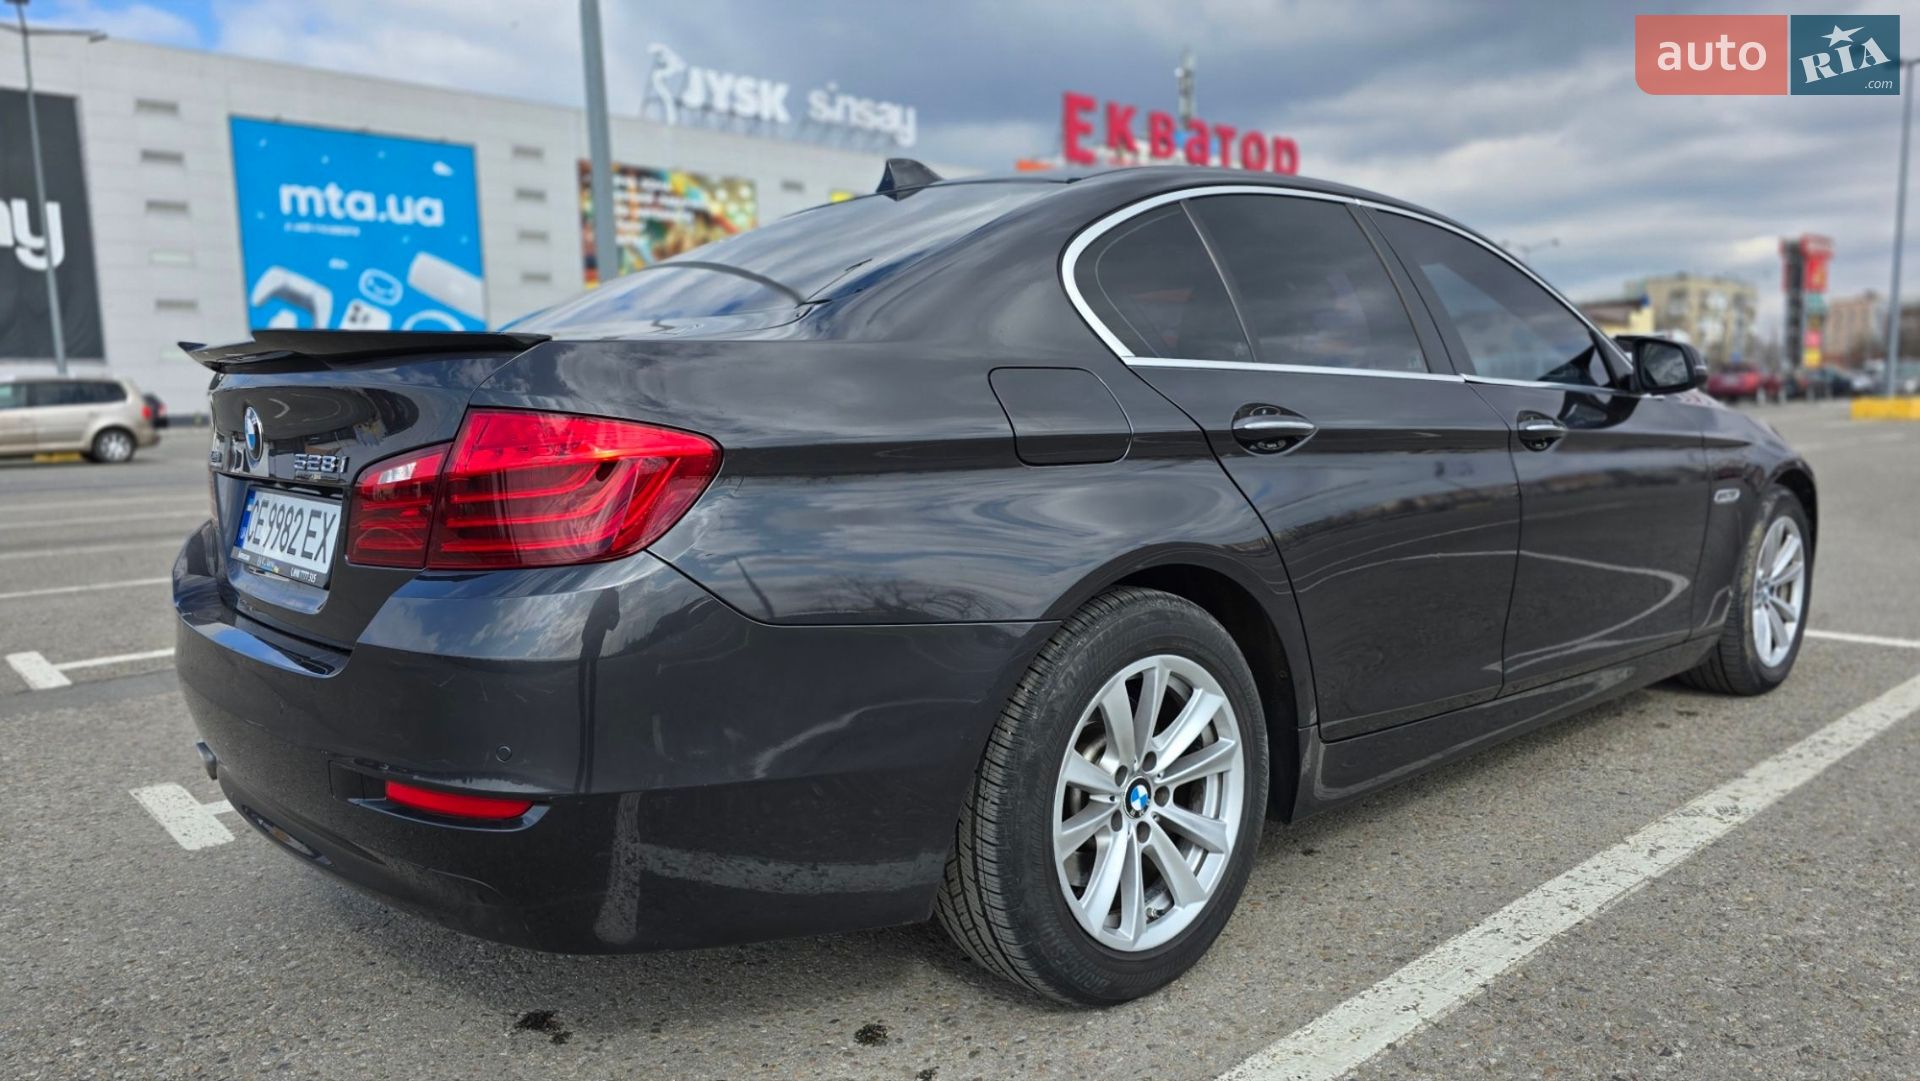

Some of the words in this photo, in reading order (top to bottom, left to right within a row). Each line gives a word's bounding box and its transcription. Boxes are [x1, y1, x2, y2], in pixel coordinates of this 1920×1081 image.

[682, 65, 790, 124] JYSK
[808, 81, 917, 147] sinsay
[279, 181, 445, 227] mta.ua
[247, 499, 270, 546] CE
[262, 502, 305, 556] 9982
[300, 508, 337, 564] EX
